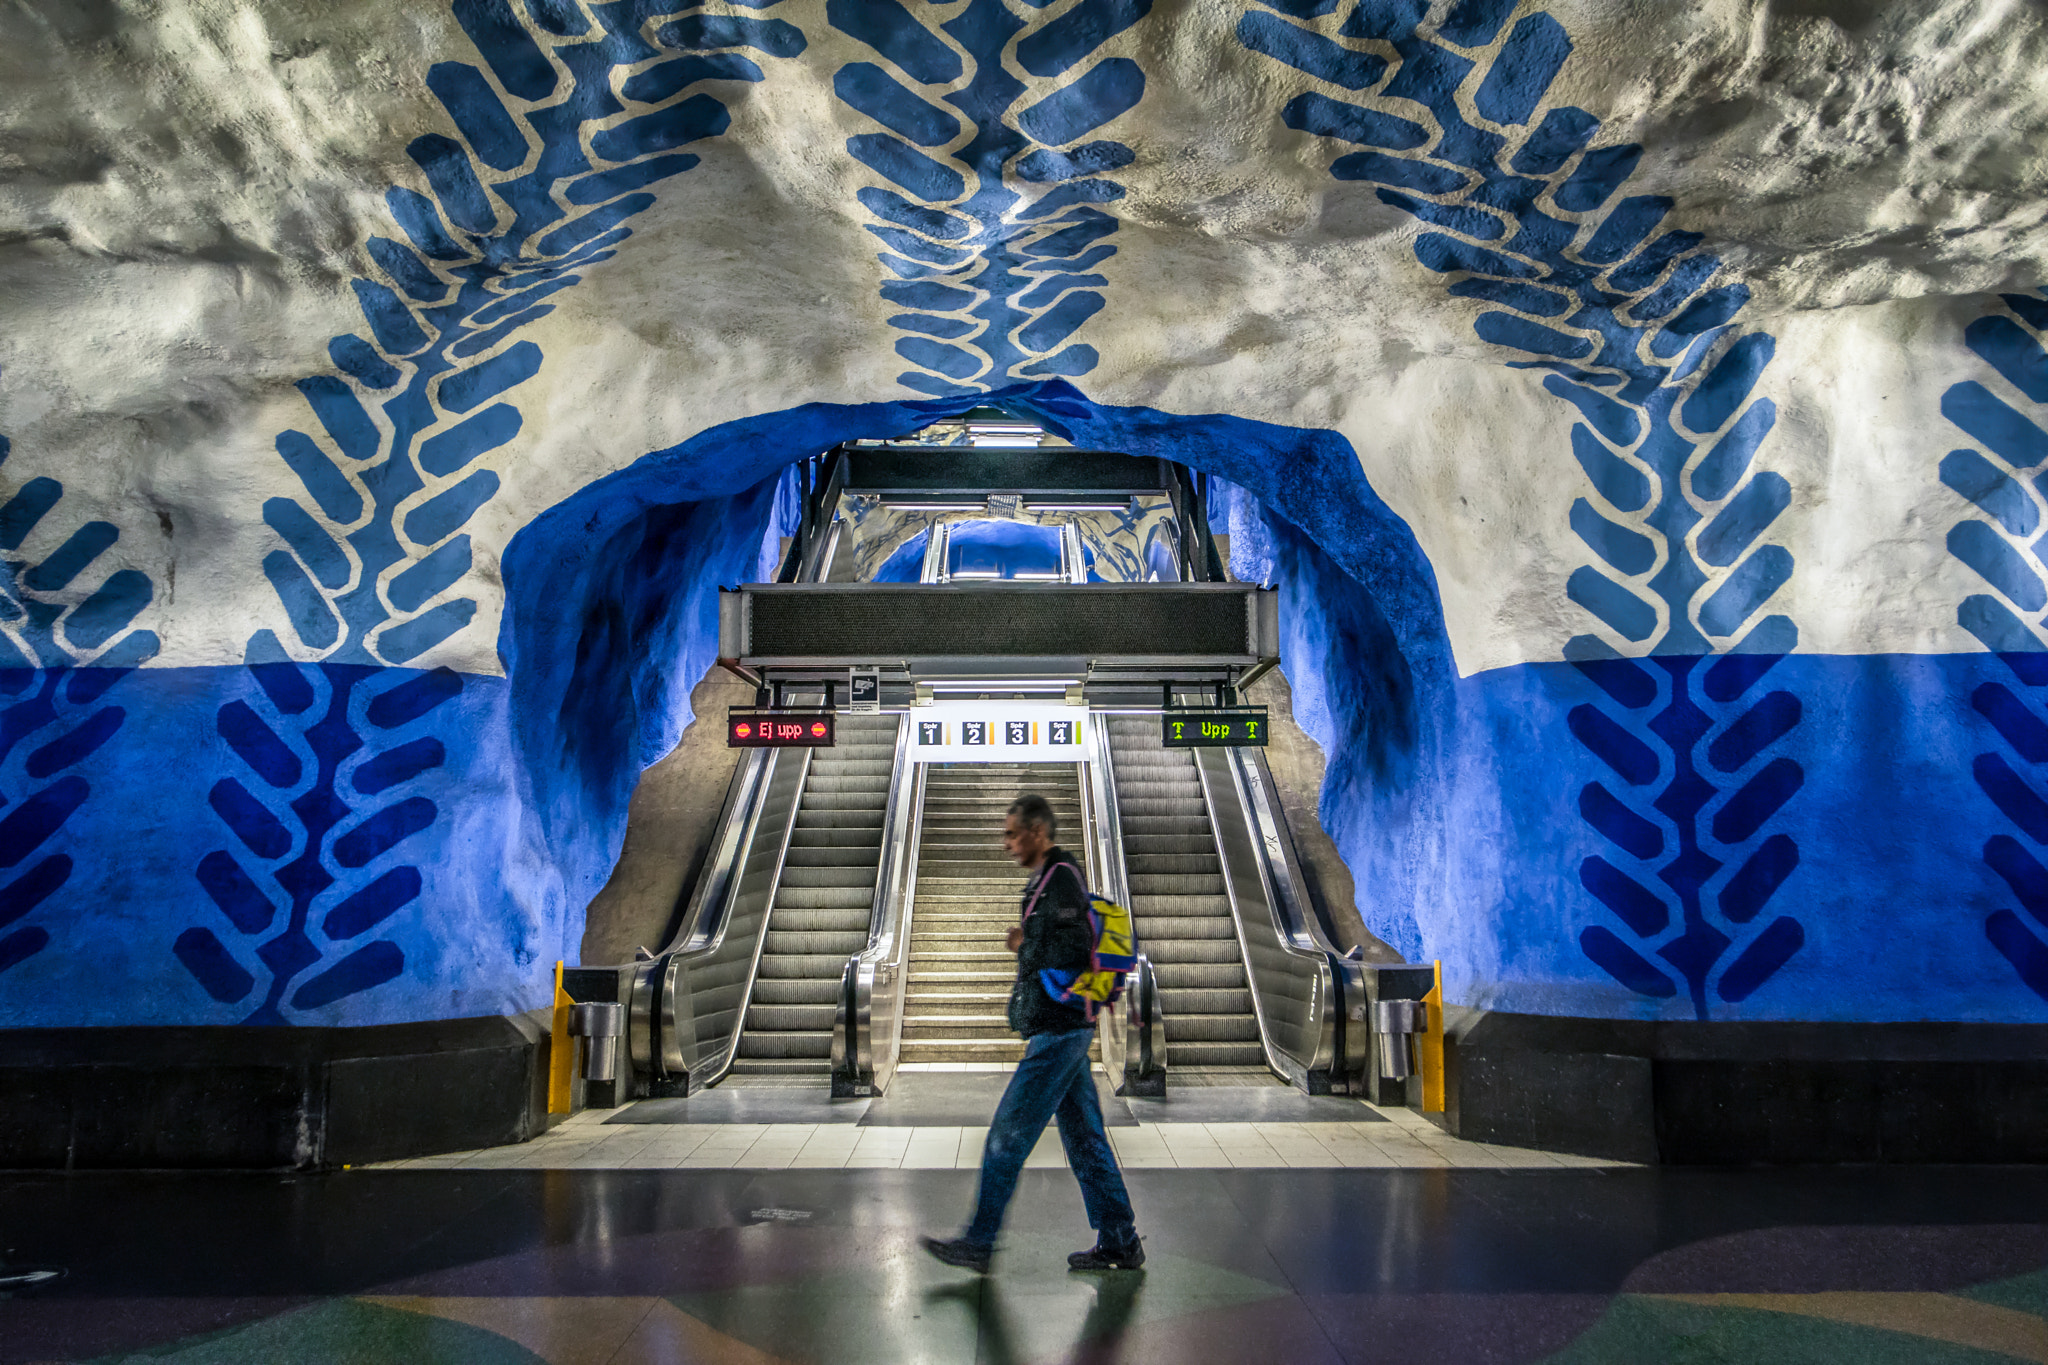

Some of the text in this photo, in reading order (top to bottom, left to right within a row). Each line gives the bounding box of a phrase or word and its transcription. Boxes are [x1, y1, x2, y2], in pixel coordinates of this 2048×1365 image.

[759, 722, 803, 740] Ej upp
[925, 729, 934, 744] 1
[968, 729, 980, 744] 2
[1012, 729, 1024, 744] 3
[1053, 729, 1066, 743] 4
[1201, 721, 1230, 739] Upp
